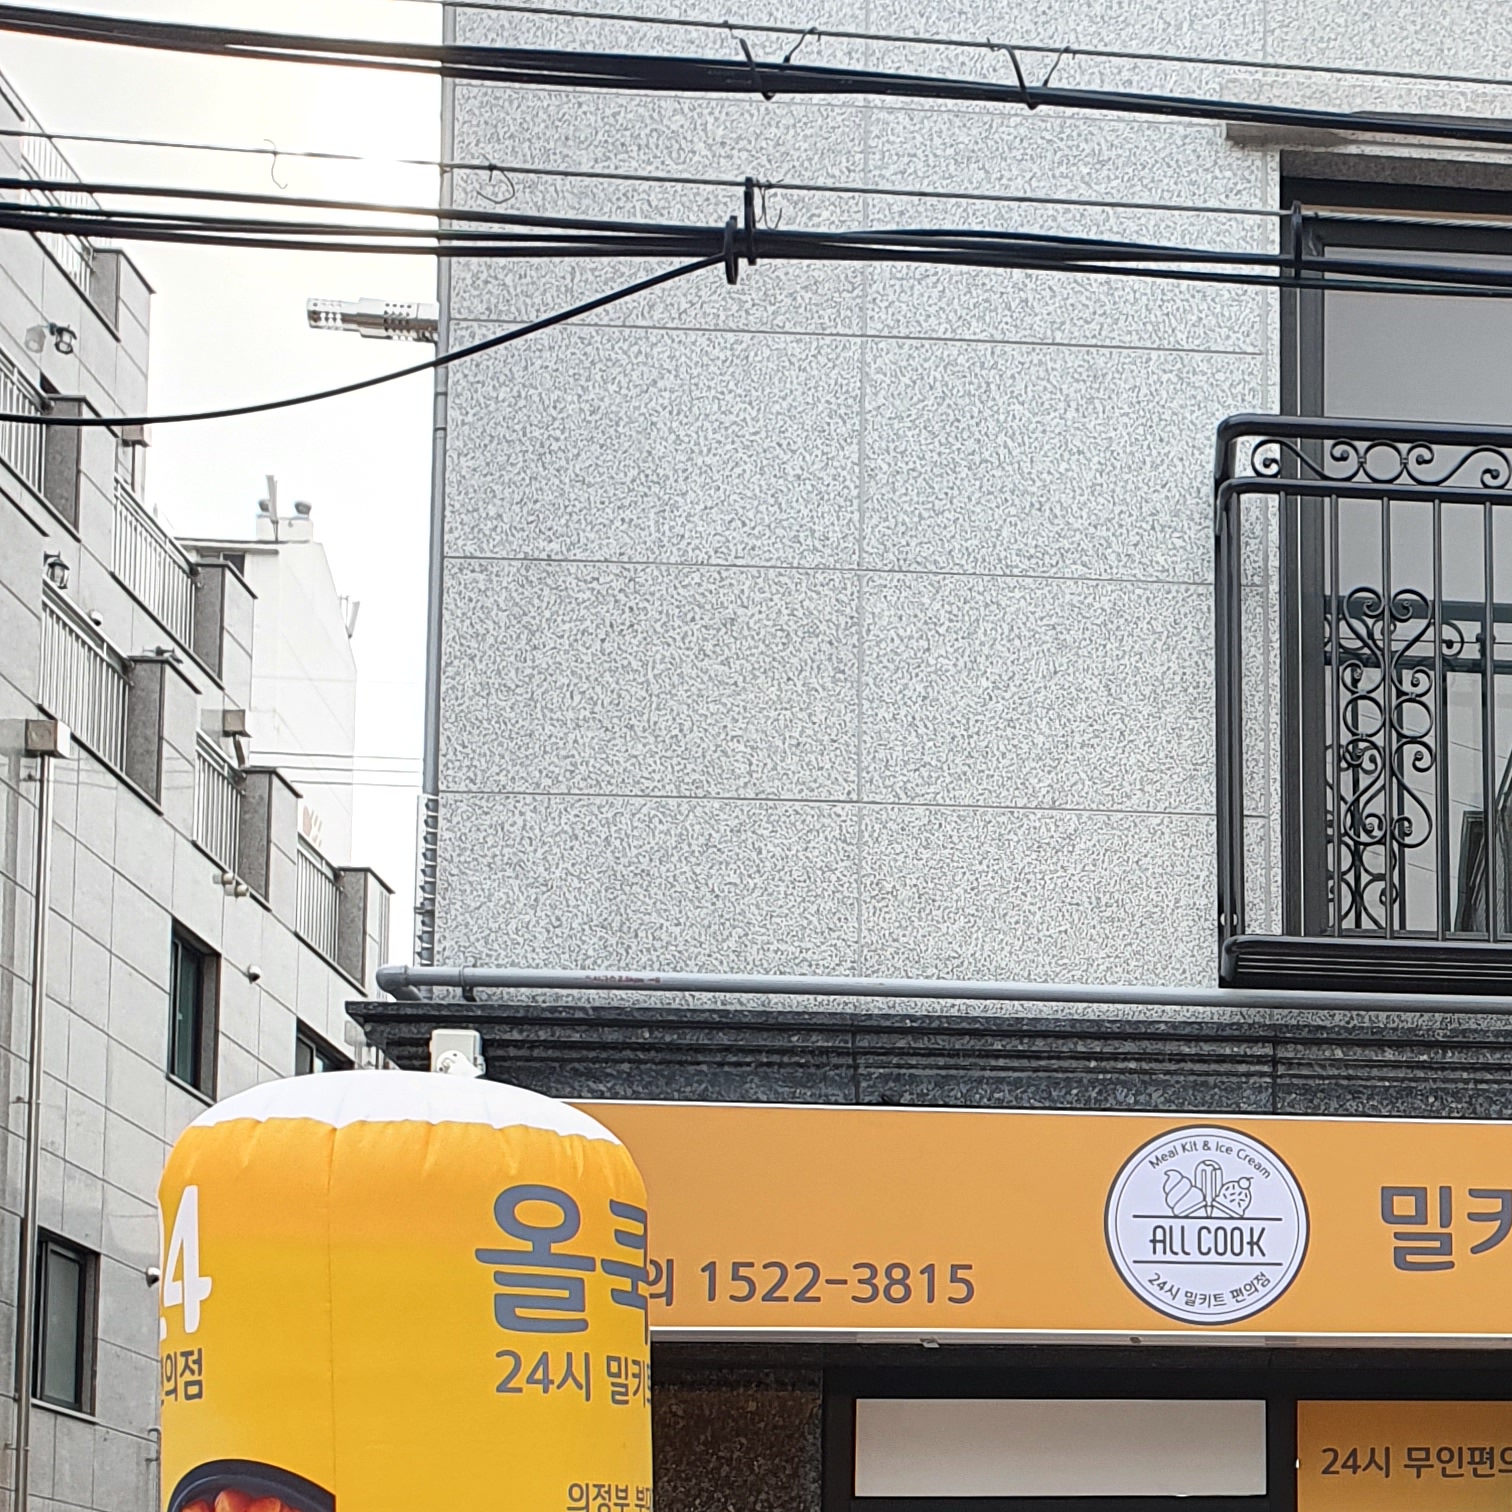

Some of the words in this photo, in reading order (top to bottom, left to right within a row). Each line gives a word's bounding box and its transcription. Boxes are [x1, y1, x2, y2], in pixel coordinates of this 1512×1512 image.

[1148, 1146, 1179, 1169] Meal
[1181, 1141, 1199, 1153] Kit
[1202, 1141, 1211, 1151] &
[1215, 1141, 1233, 1154] Ice
[1236, 1149, 1271, 1179] Cream
[1149, 1225, 1191, 1256] ALL
[1197, 1226, 1266, 1257] COOK
[159, 1184, 212, 1342] 4
[701, 1261, 974, 1305] 1522-3815
[1147, 1272, 1181, 1300] 24시
[1184, 1290, 1228, 1308] 밀키트
[1229, 1272, 1271, 1303] 편의점
[160, 1347, 203, 1407] 의점
[496, 1350, 591, 1403] 24시
[1321, 1447, 1391, 1478] 24시
